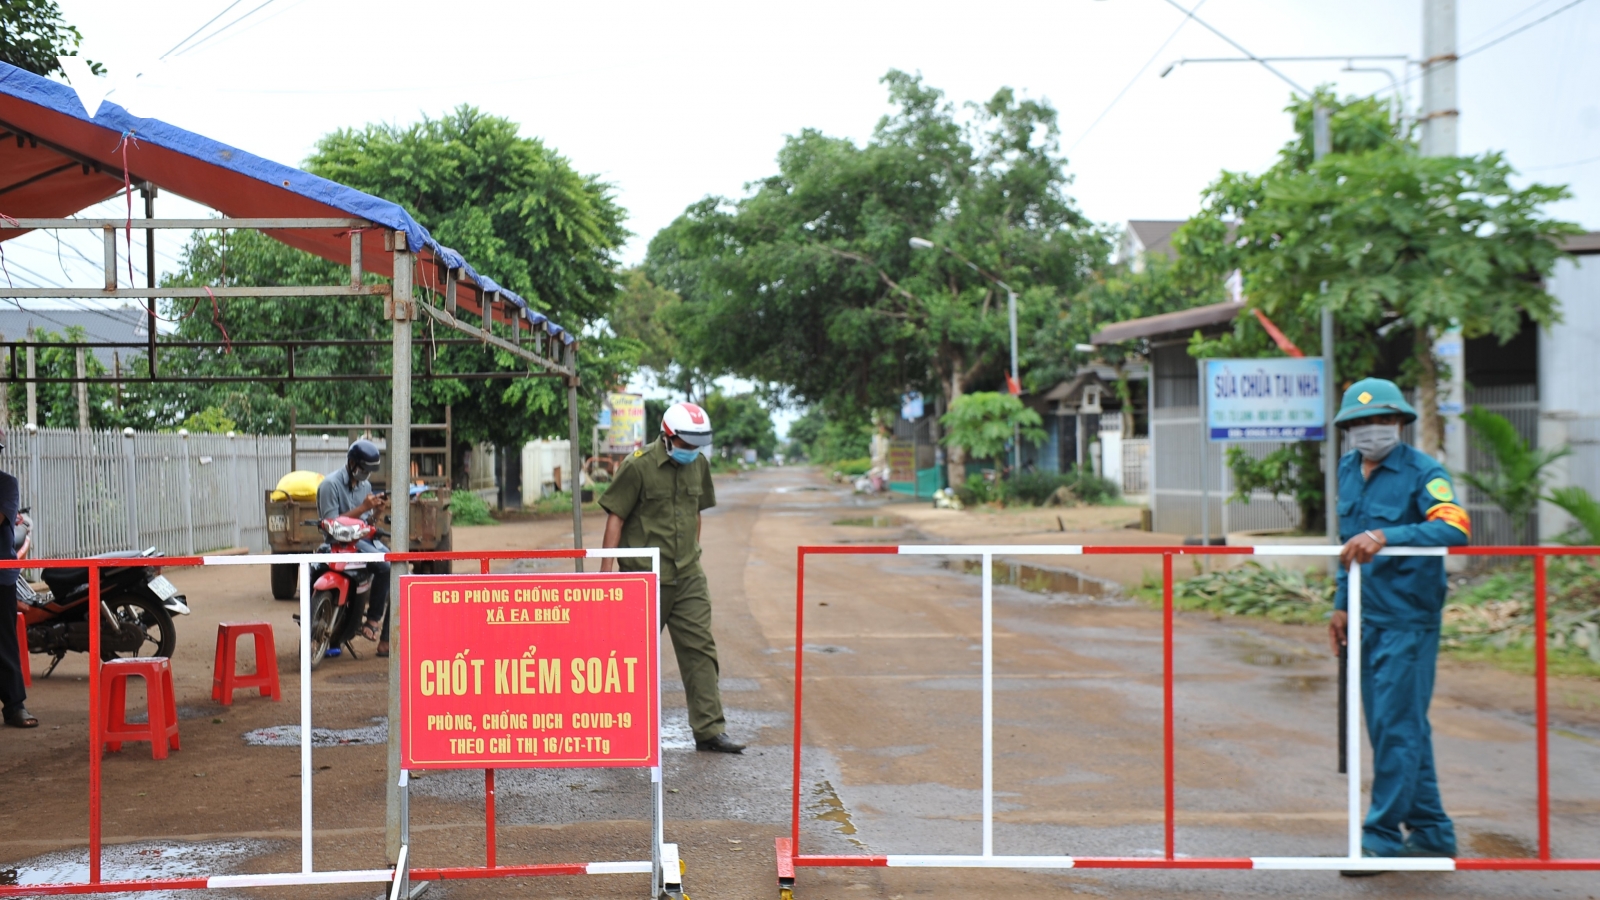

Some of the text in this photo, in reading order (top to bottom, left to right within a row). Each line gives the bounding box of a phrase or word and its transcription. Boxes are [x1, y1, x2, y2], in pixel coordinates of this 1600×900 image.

[433, 585, 623, 603] BCĐ PHÒNG CHỐNG COVID-19
[486, 605, 571, 622] XÃ EA BHỐK
[420, 645, 638, 696] CHỐT KIỂM SOÁT
[427, 710, 632, 732] PHÒNG, CHỐNG DỊCH COVID-19
[449, 735, 611, 757] THEO CHỈ THỊ 16/CT-TTg
